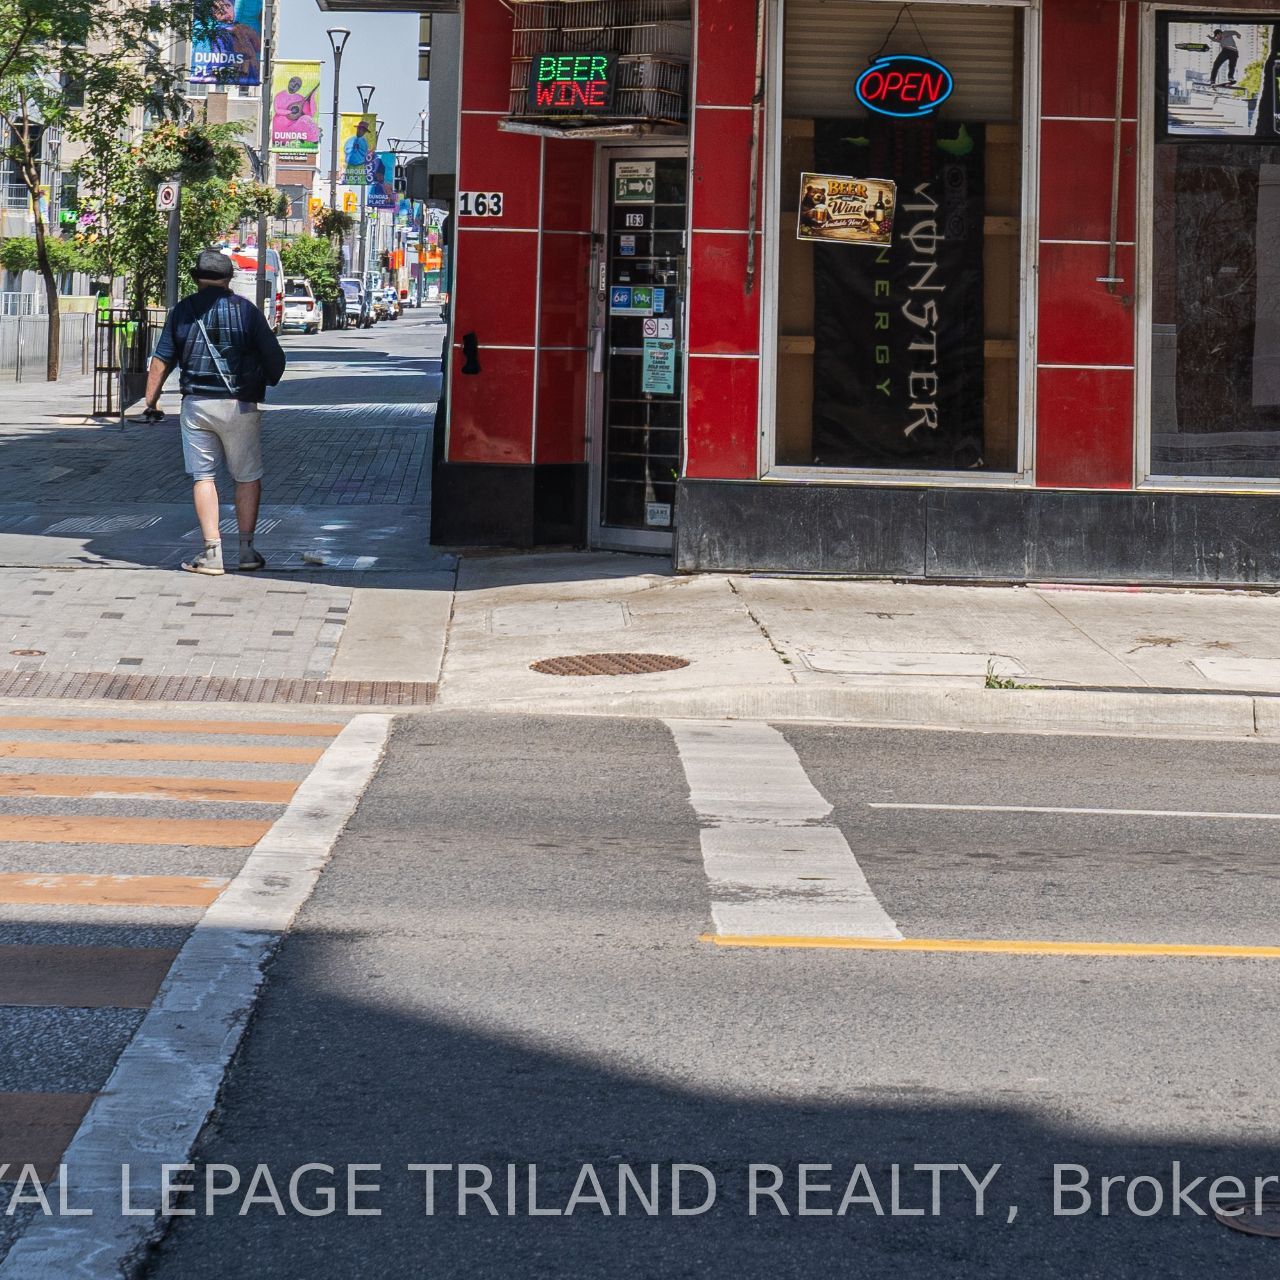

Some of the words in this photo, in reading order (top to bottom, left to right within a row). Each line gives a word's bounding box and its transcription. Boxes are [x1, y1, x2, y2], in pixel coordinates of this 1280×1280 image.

[194, 52, 244, 64] DUNDAS
[538, 56, 608, 81] BEER
[536, 81, 608, 107] WINE
[861, 72, 944, 102] OPEN
[274, 131, 308, 140] DUNDAS
[274, 140, 301, 149] PLACE
[827, 180, 869, 199] BEER
[460, 192, 503, 216] 163
[828, 201, 863, 215] Wine
[627, 214, 644, 226] 163
[901, 182, 946, 438] MONSTER
[875, 247, 890, 397] NERGY
